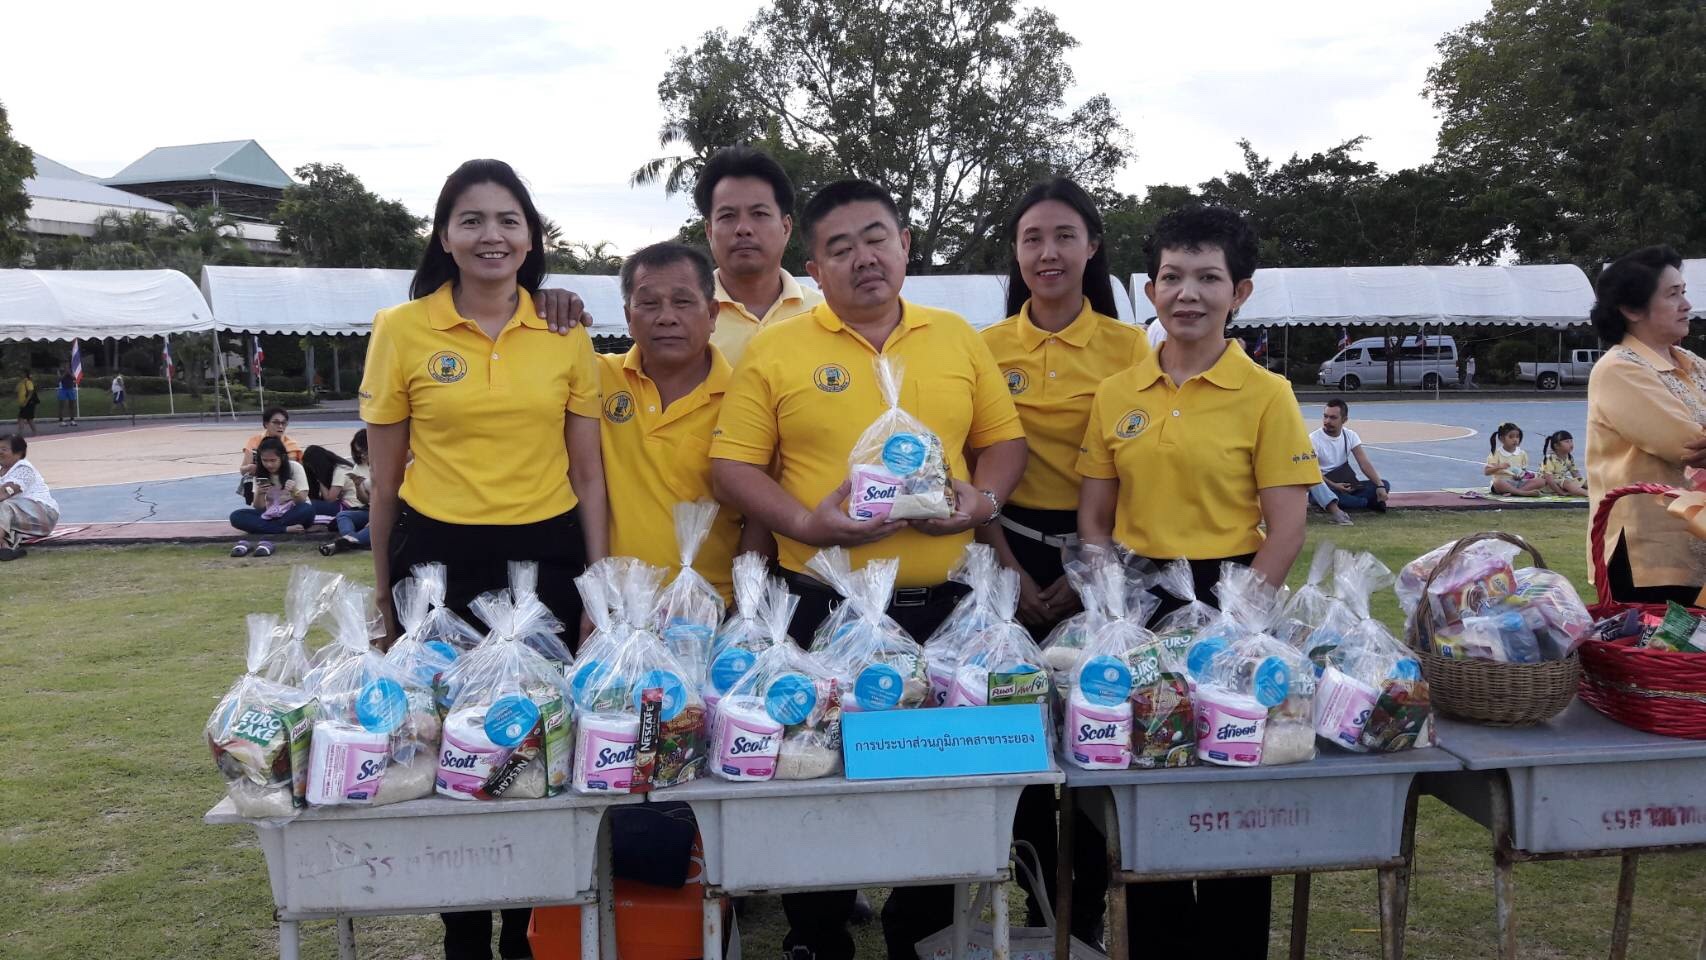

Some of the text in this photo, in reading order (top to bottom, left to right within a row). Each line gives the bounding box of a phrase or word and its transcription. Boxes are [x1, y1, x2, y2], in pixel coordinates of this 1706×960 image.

[863, 486, 896, 500] Scott
[239, 710, 282, 730] EURO
[234, 721, 276, 741] CAKE
[1078, 723, 1117, 742] Scott
[730, 735, 772, 755] Scott
[855, 733, 1035, 752] การประปาส่วนภูมิภาคสาขาระยอง
[441, 750, 479, 769] Scott
[595, 744, 637, 768] Scott
